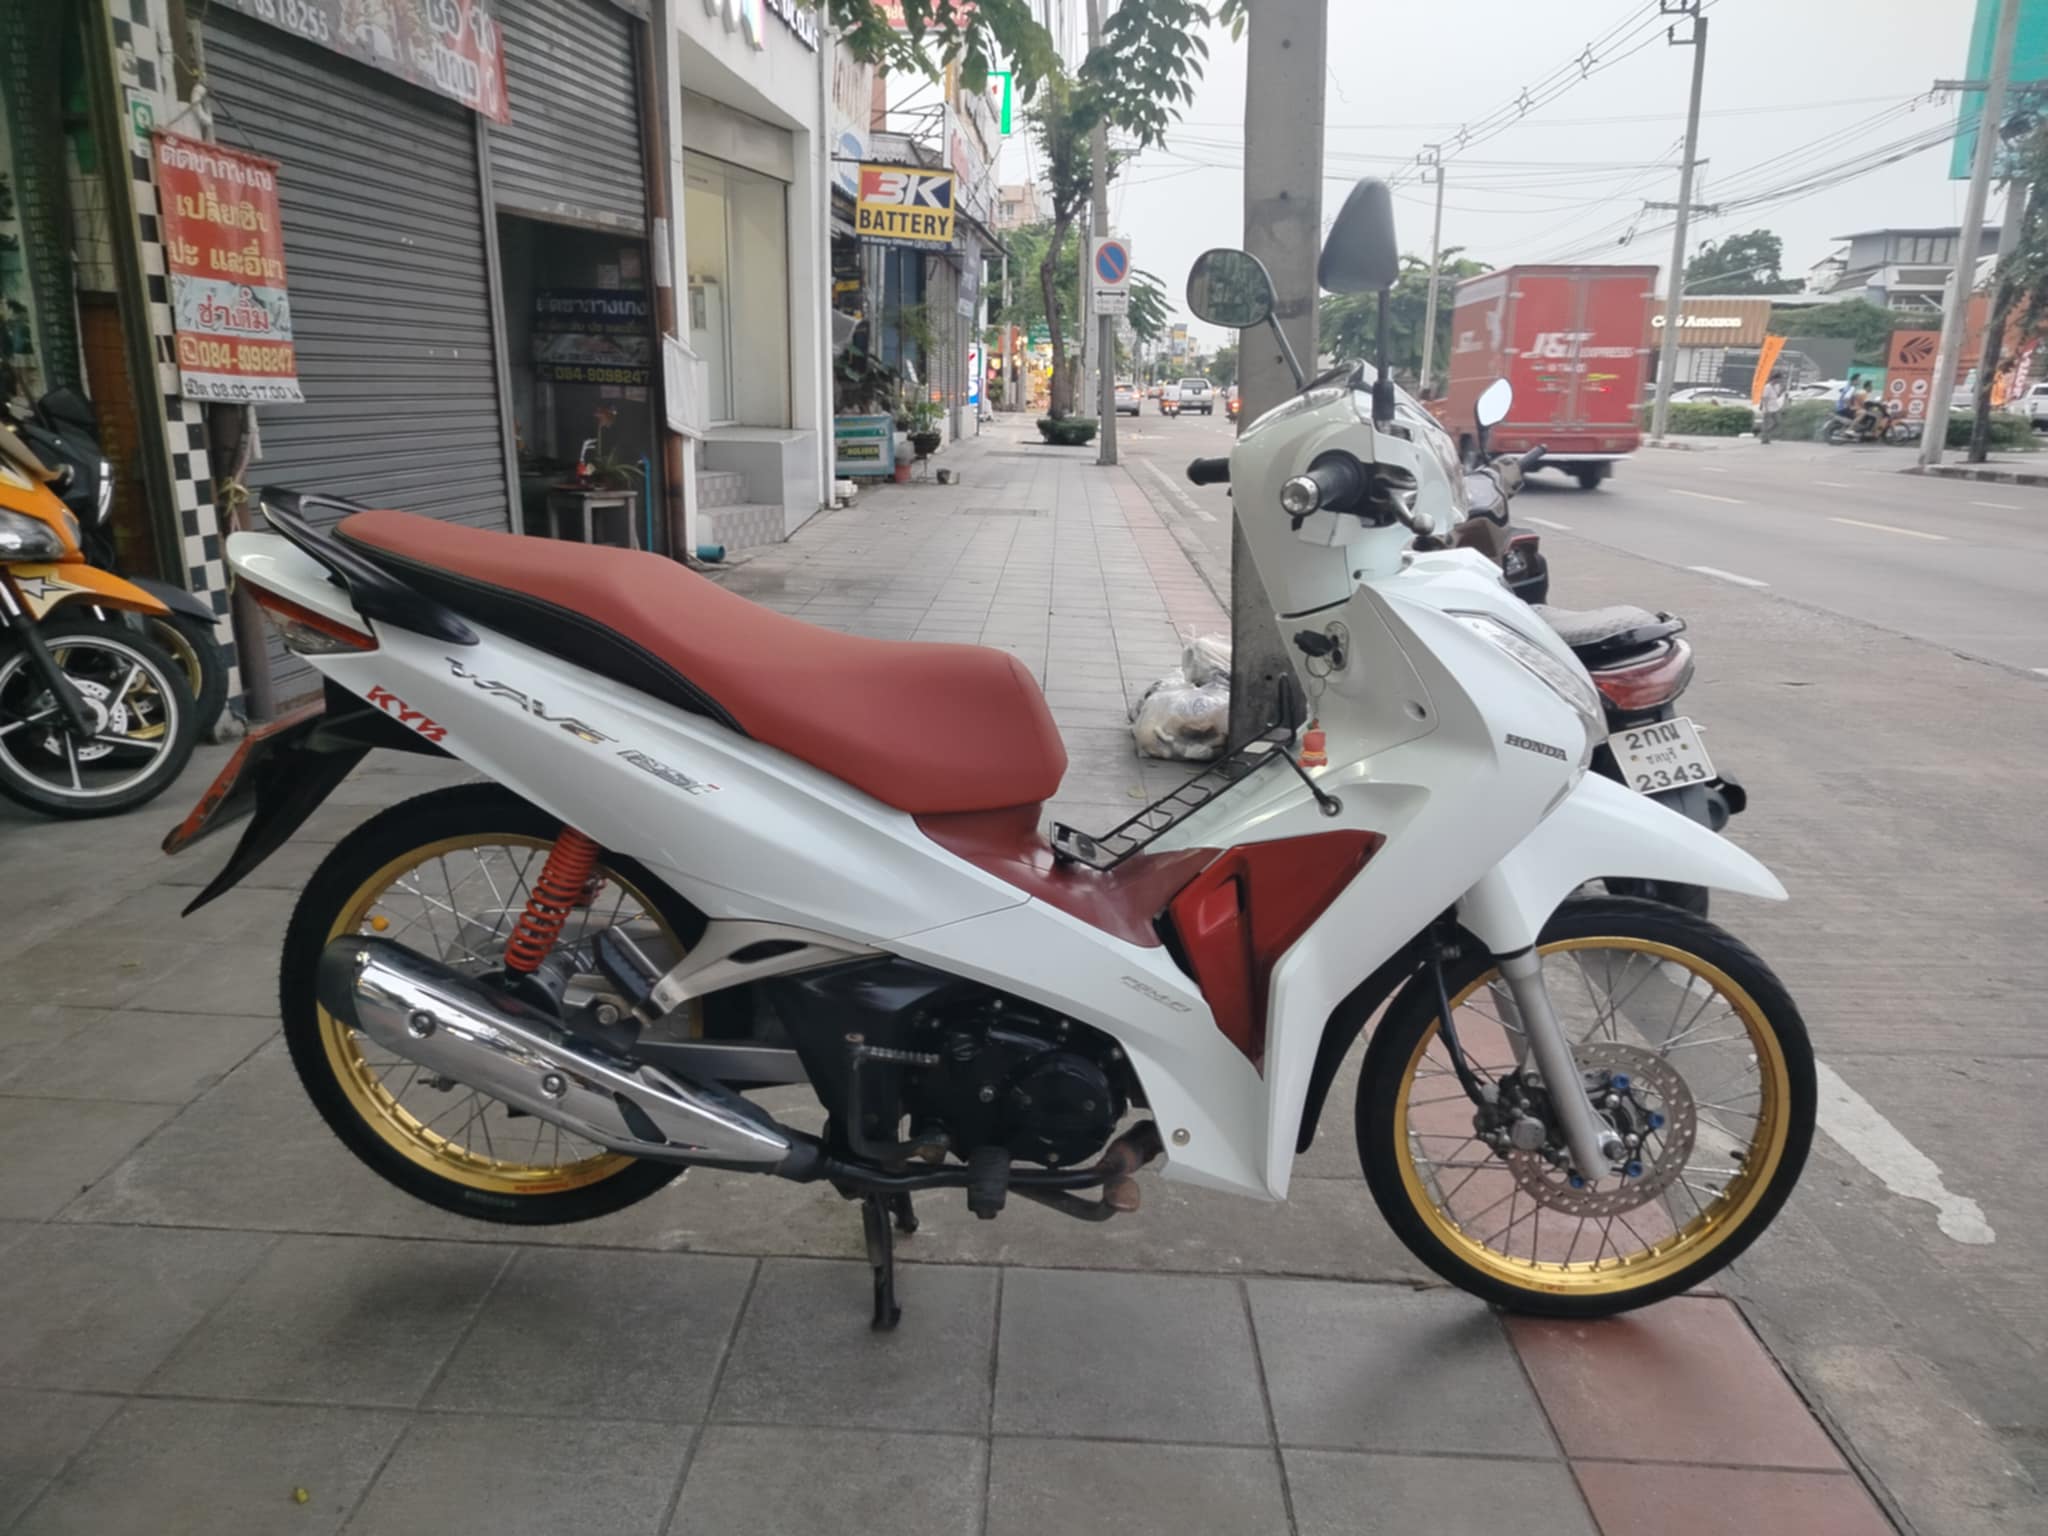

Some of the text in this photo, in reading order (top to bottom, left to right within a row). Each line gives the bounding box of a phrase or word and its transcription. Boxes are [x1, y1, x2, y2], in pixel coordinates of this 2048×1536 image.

[863, 171, 951, 209] 3K
[859, 208, 950, 236] BATTERY
[366, 684, 447, 742] KYB
[1504, 733, 1569, 761] HONDA
[1635, 762, 1706, 792] 2343
